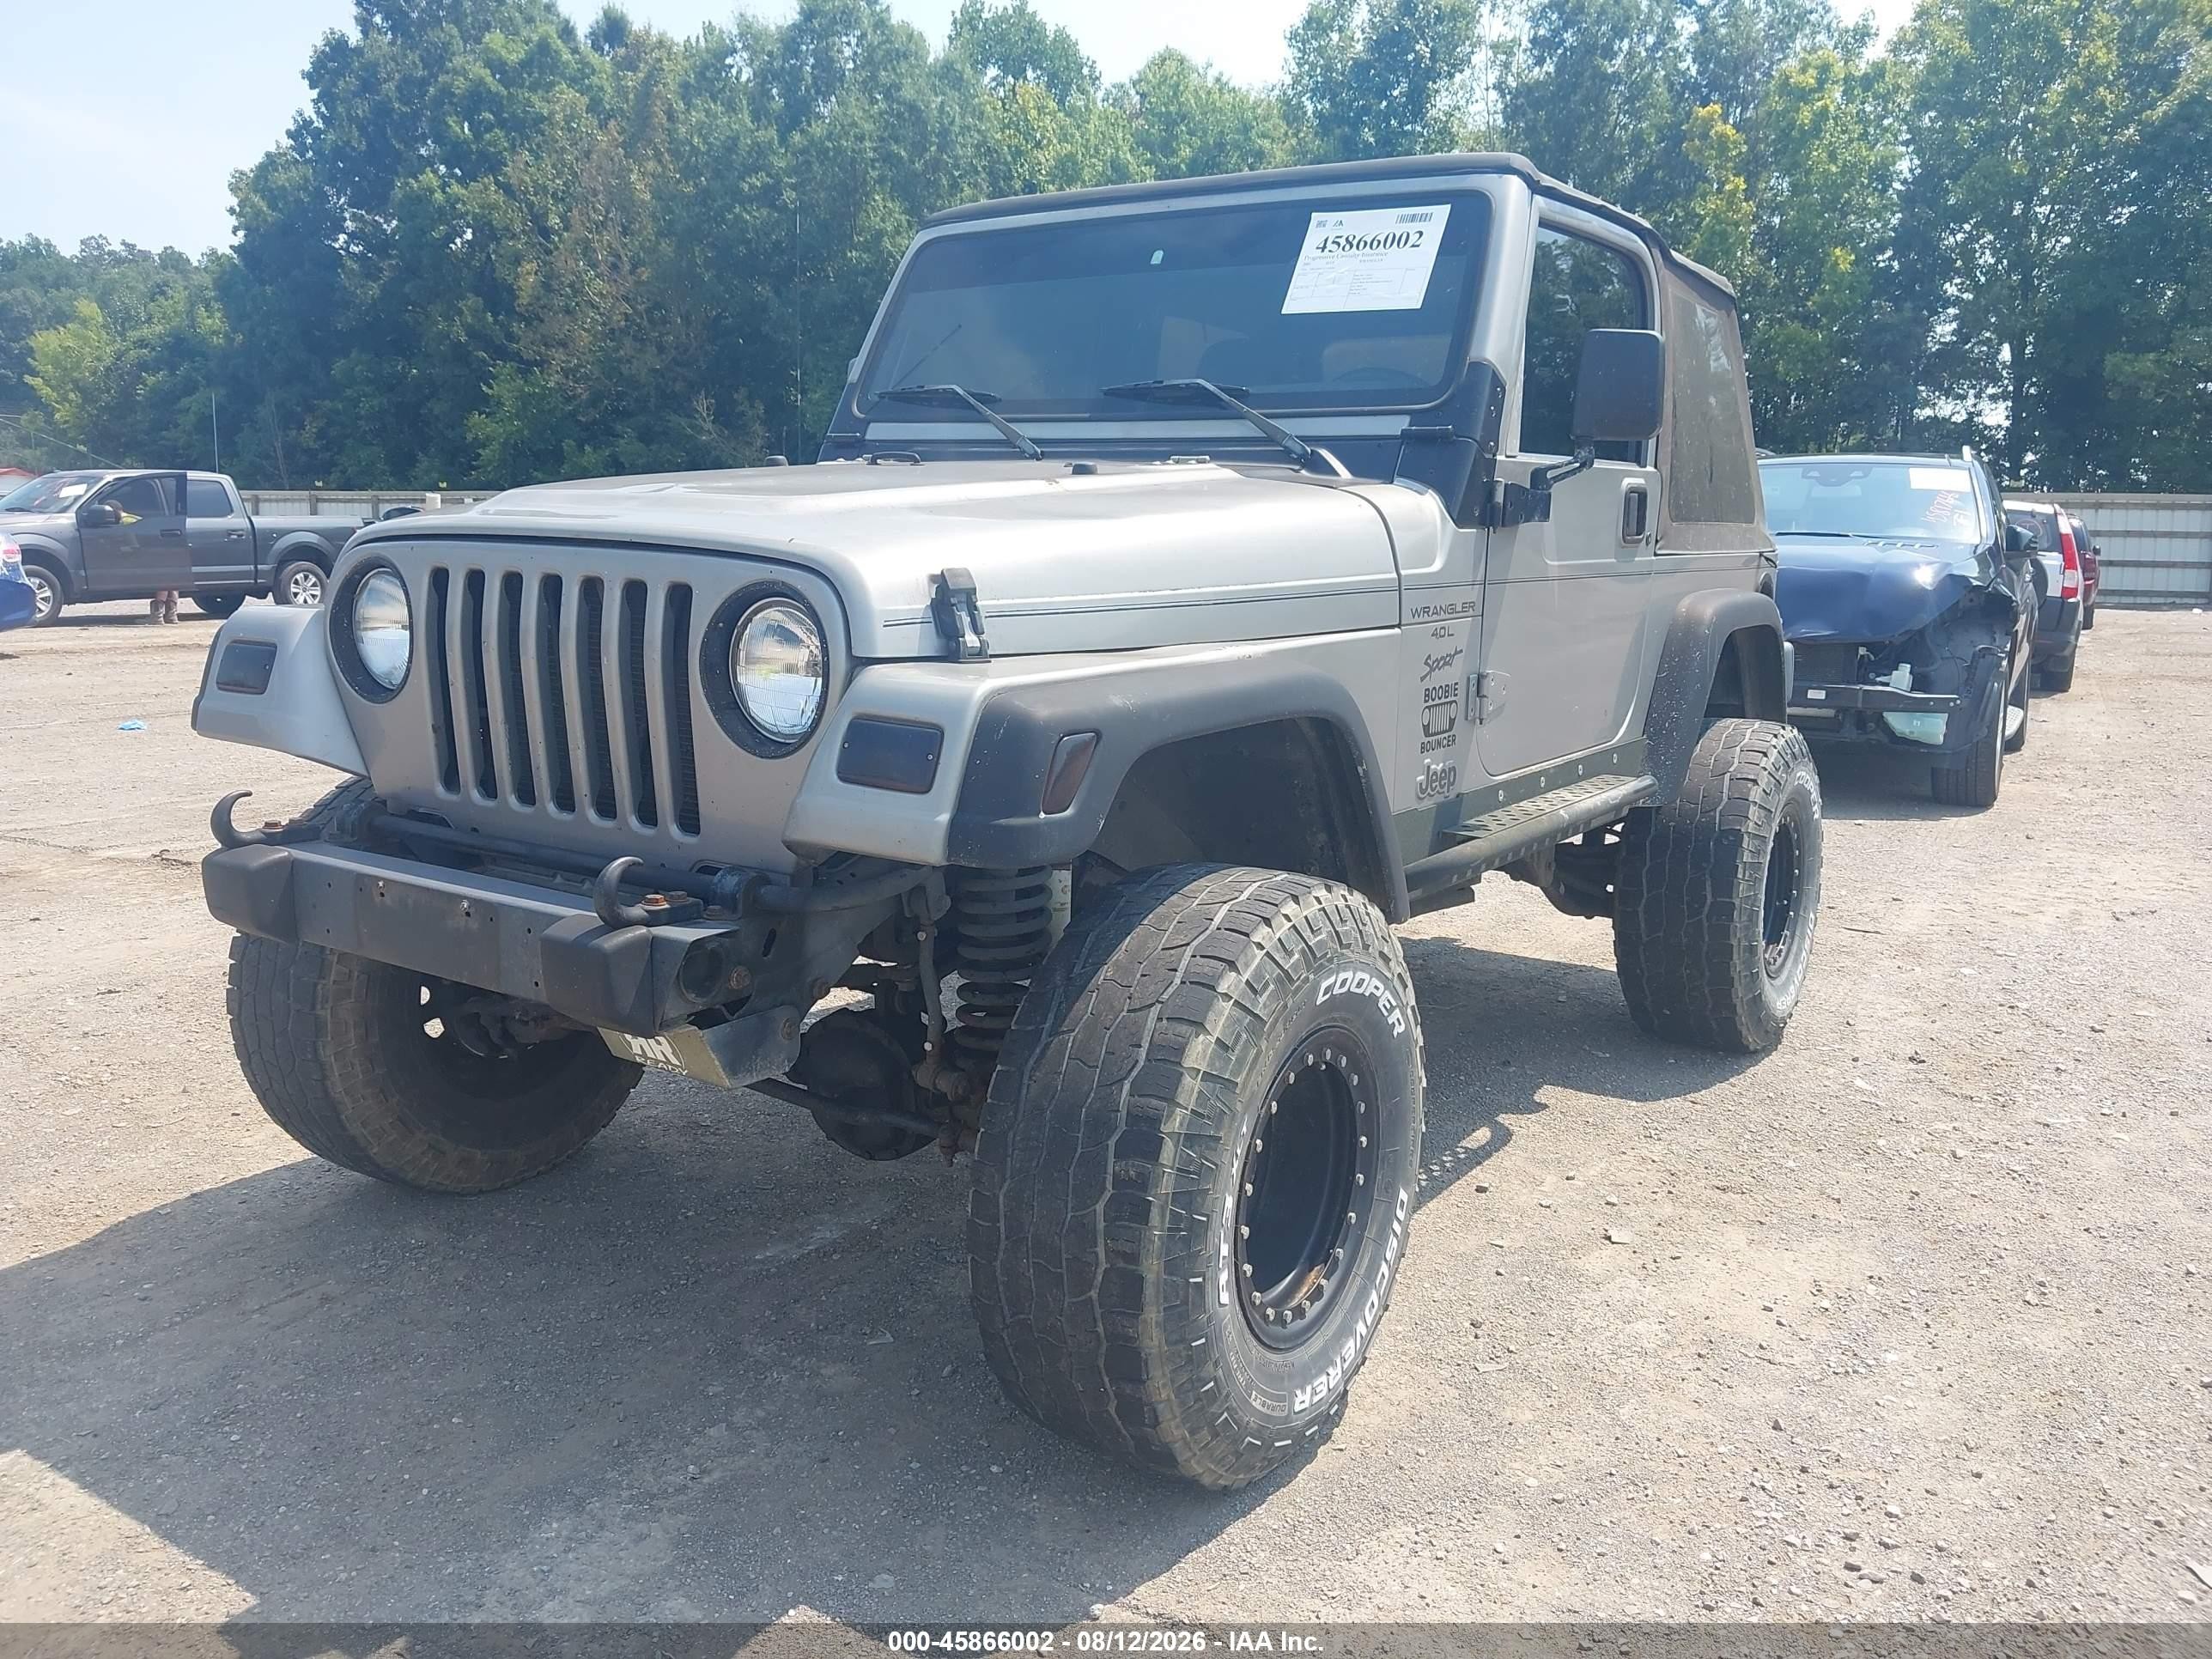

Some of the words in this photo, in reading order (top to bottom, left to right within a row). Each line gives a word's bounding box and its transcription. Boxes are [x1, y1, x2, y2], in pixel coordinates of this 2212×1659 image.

[1316, 230, 1424, 253] 45866002
[1411, 601, 1475, 619] WRANGLER
[1419, 646, 1463, 683] Sport
[1424, 682, 1459, 704] BOOBIE
[1419, 734, 1457, 755] BOUNCER
[1416, 759, 1457, 799] Jeep
[1795, 771, 1819, 821] COOPER
[1316, 970, 1407, 1039] COOPER
[635, 1055, 688, 1076] READY
[1292, 1187, 1409, 1413] DISCOVERER
[1252, 1393, 1287, 1413] DURABLE
